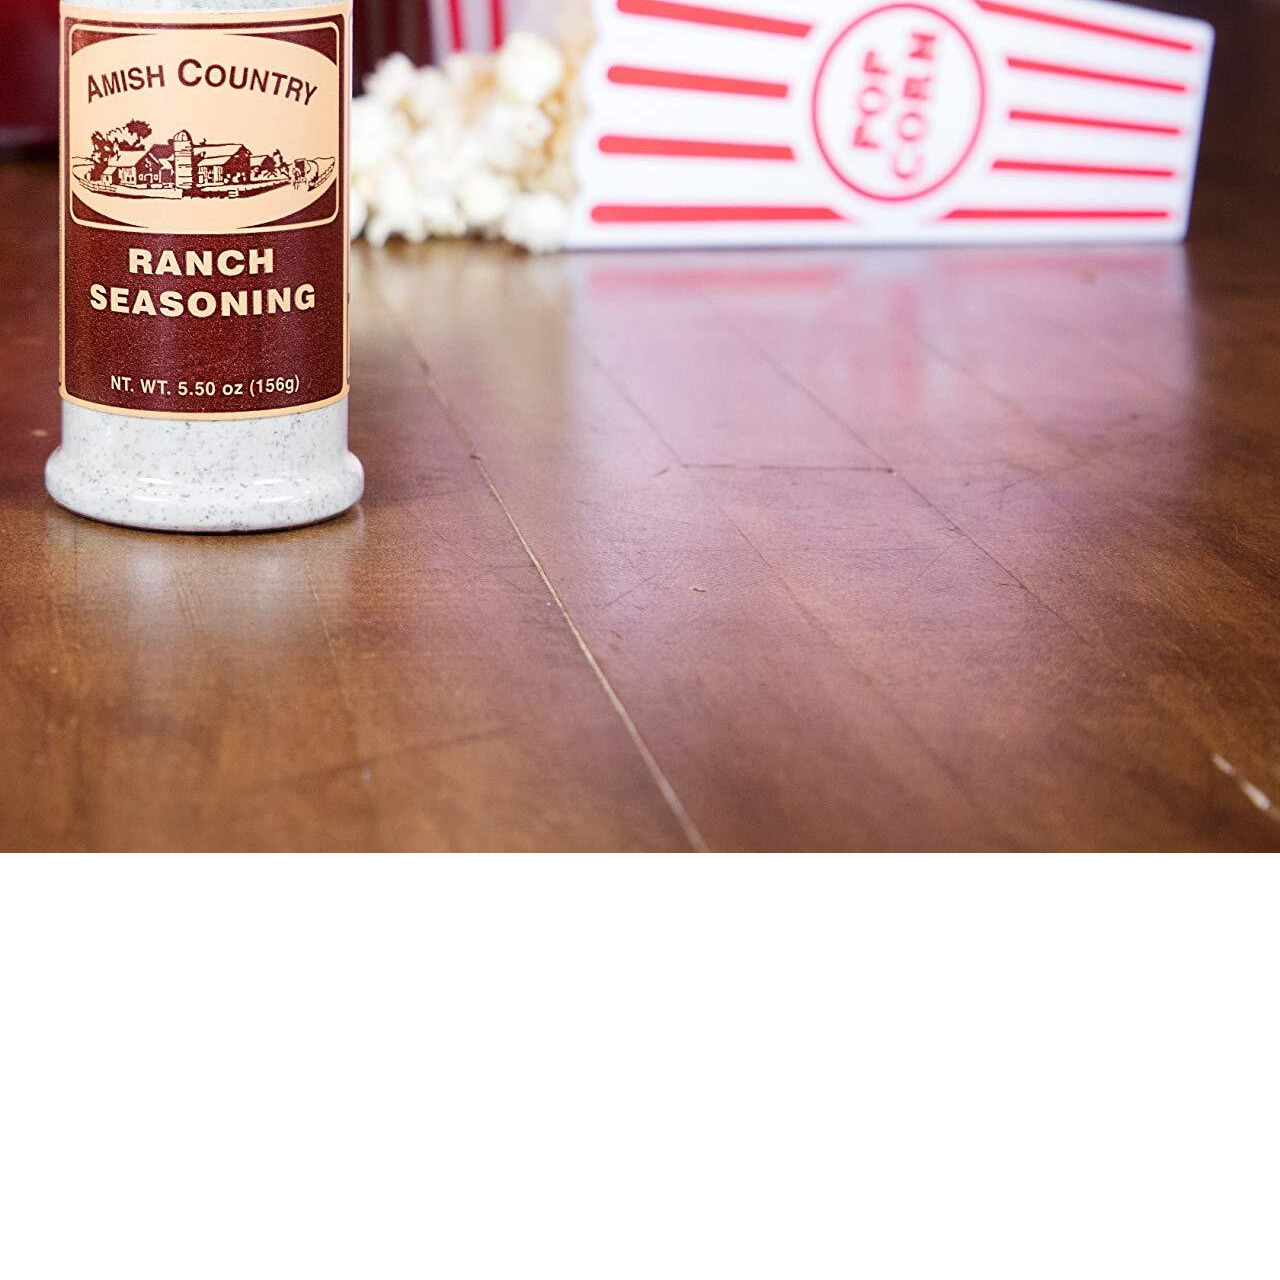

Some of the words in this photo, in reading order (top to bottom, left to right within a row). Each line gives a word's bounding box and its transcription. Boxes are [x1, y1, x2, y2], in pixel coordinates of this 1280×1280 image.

[87, 64, 166, 104] AMISH
[177, 58, 318, 106] COUNTRY
[852, 49, 890, 150] POP
[892, 31, 938, 181] CORN
[128, 247, 274, 277] RANCH
[89, 283, 316, 318] SEASONING
[110, 375, 135, 392] NT.
[140, 378, 171, 395] WT.
[178, 380, 216, 396] 5.50
[222, 382, 243, 395] oz
[249, 375, 300, 397] (156g)
